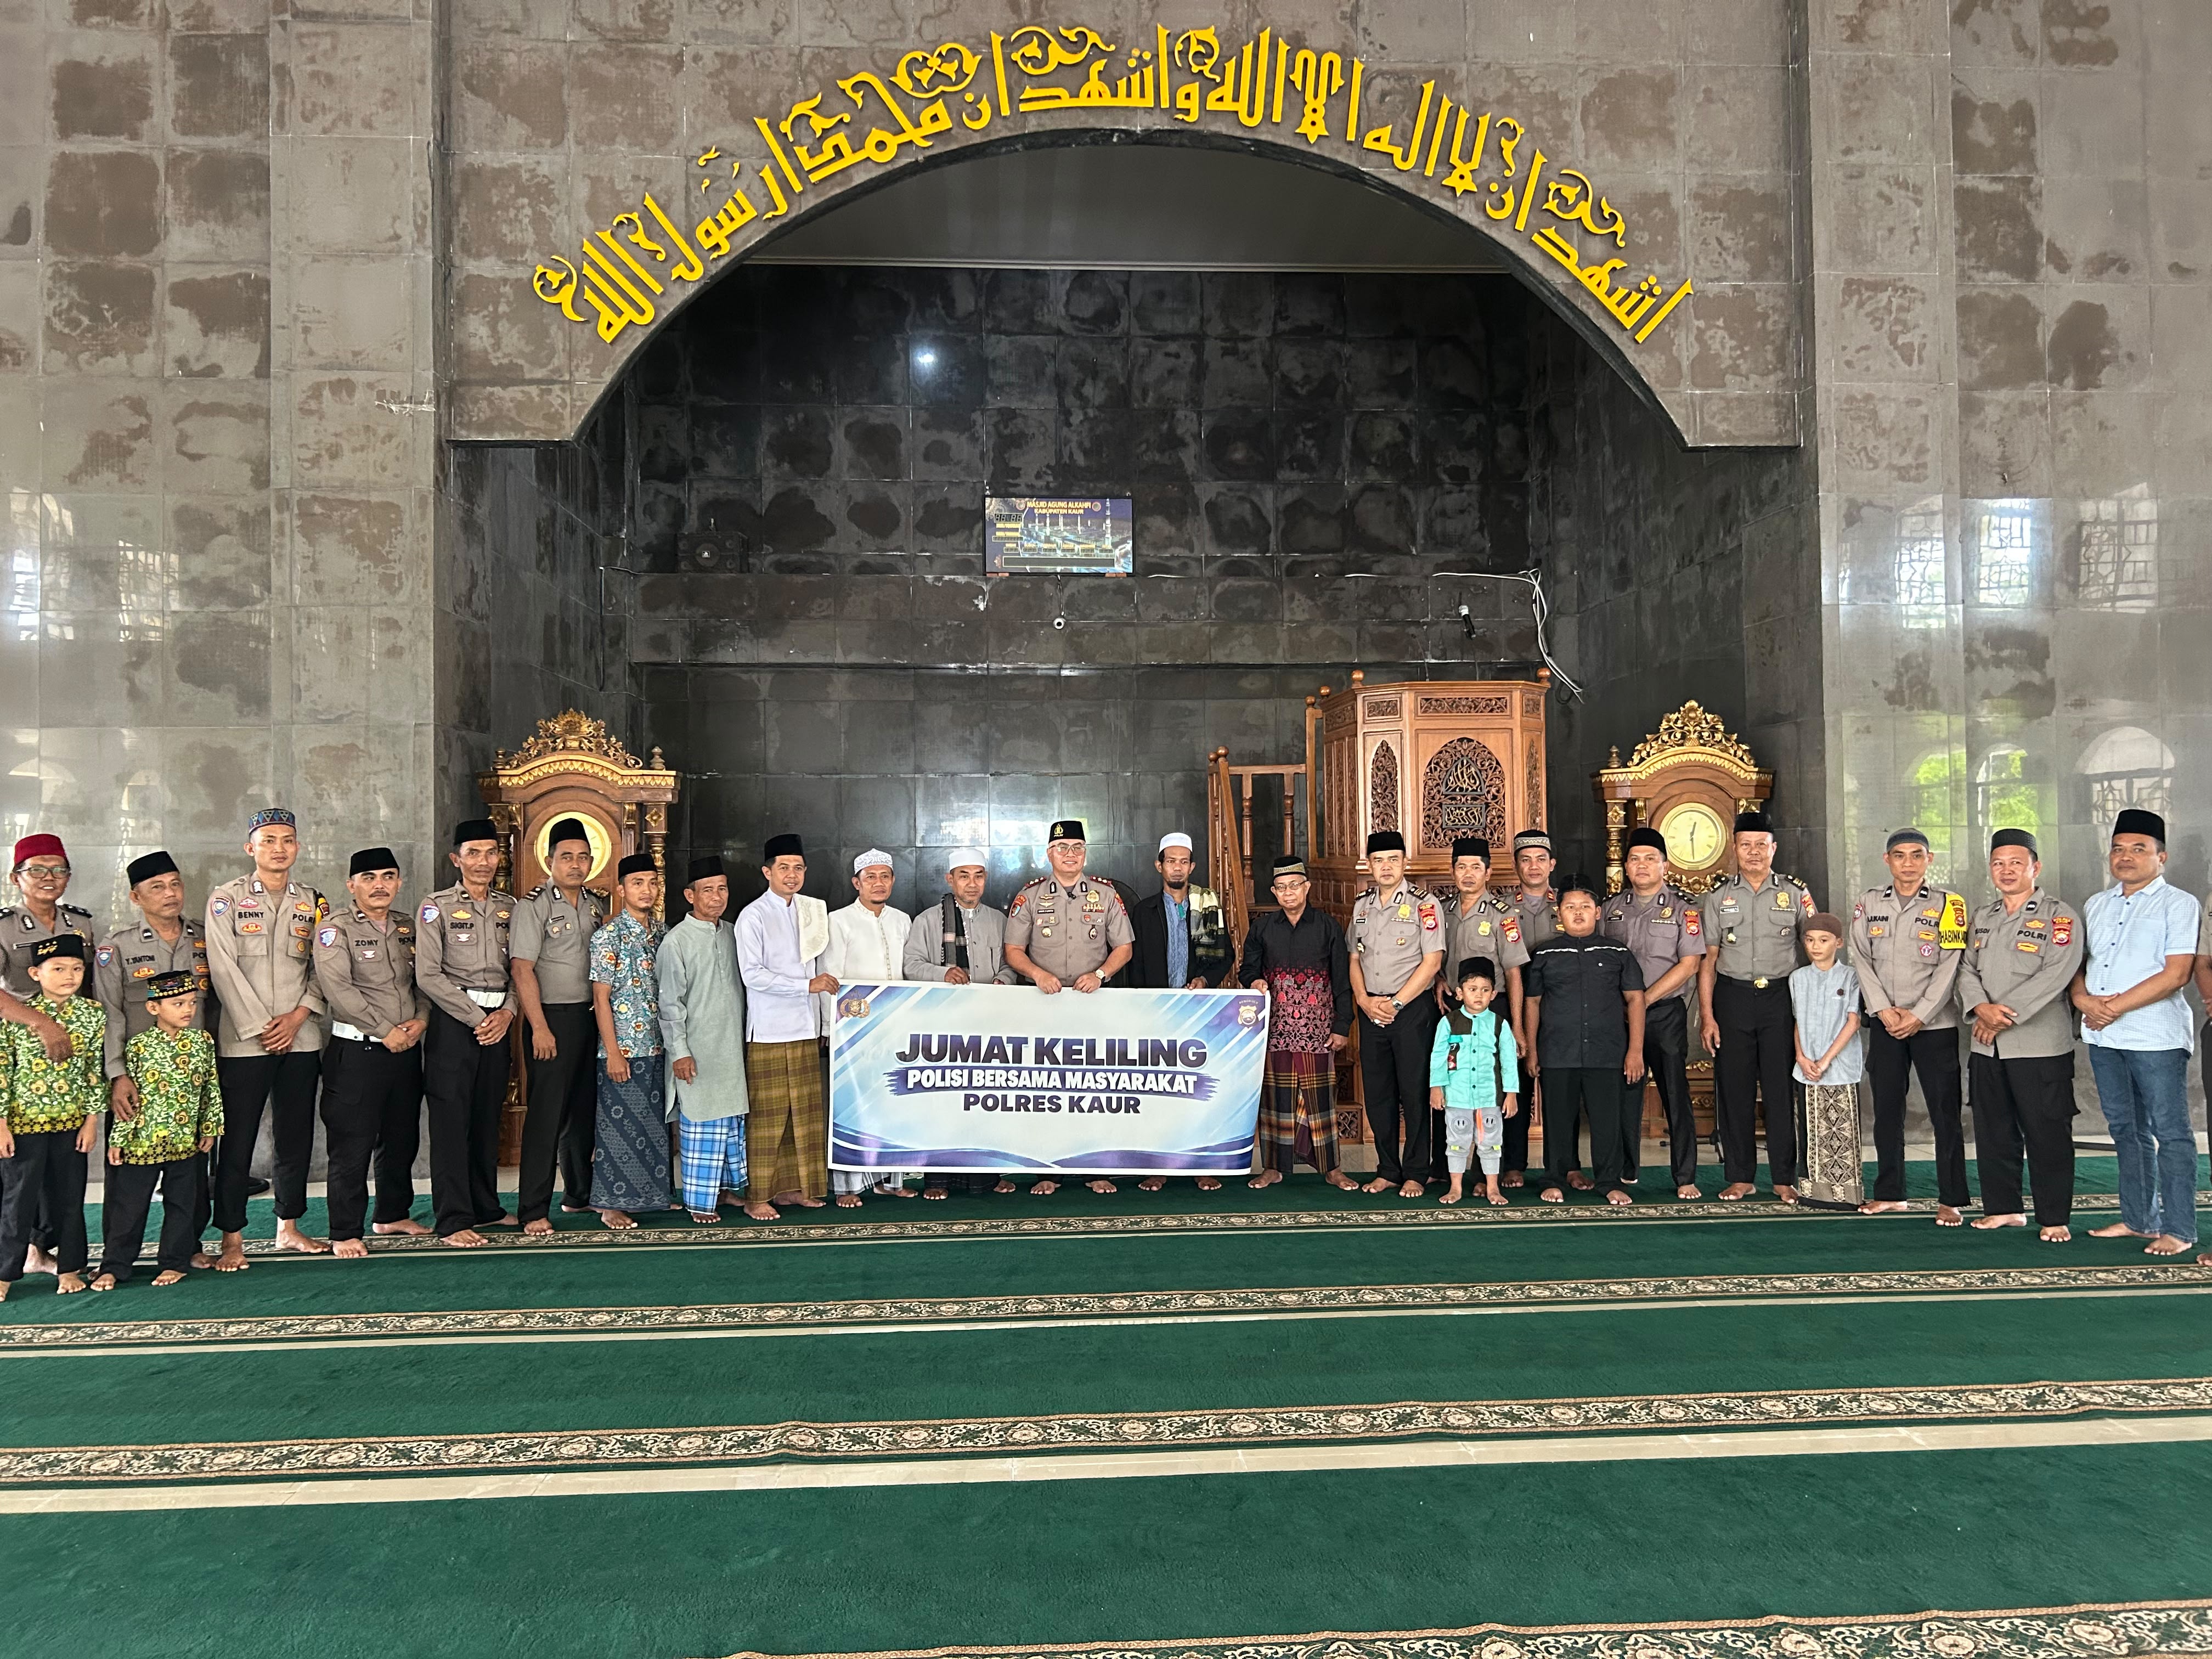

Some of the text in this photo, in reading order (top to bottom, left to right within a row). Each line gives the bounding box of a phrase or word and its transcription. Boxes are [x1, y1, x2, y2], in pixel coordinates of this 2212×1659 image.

[2017, 929, 2047, 941] POLRI
[895, 1034, 1207, 1068] JUMAT KELILING
[907, 1069, 1198, 1094] POLISI BERSAMA MASYARAKAT
[963, 1093, 1141, 1114] POLRES KAUR
